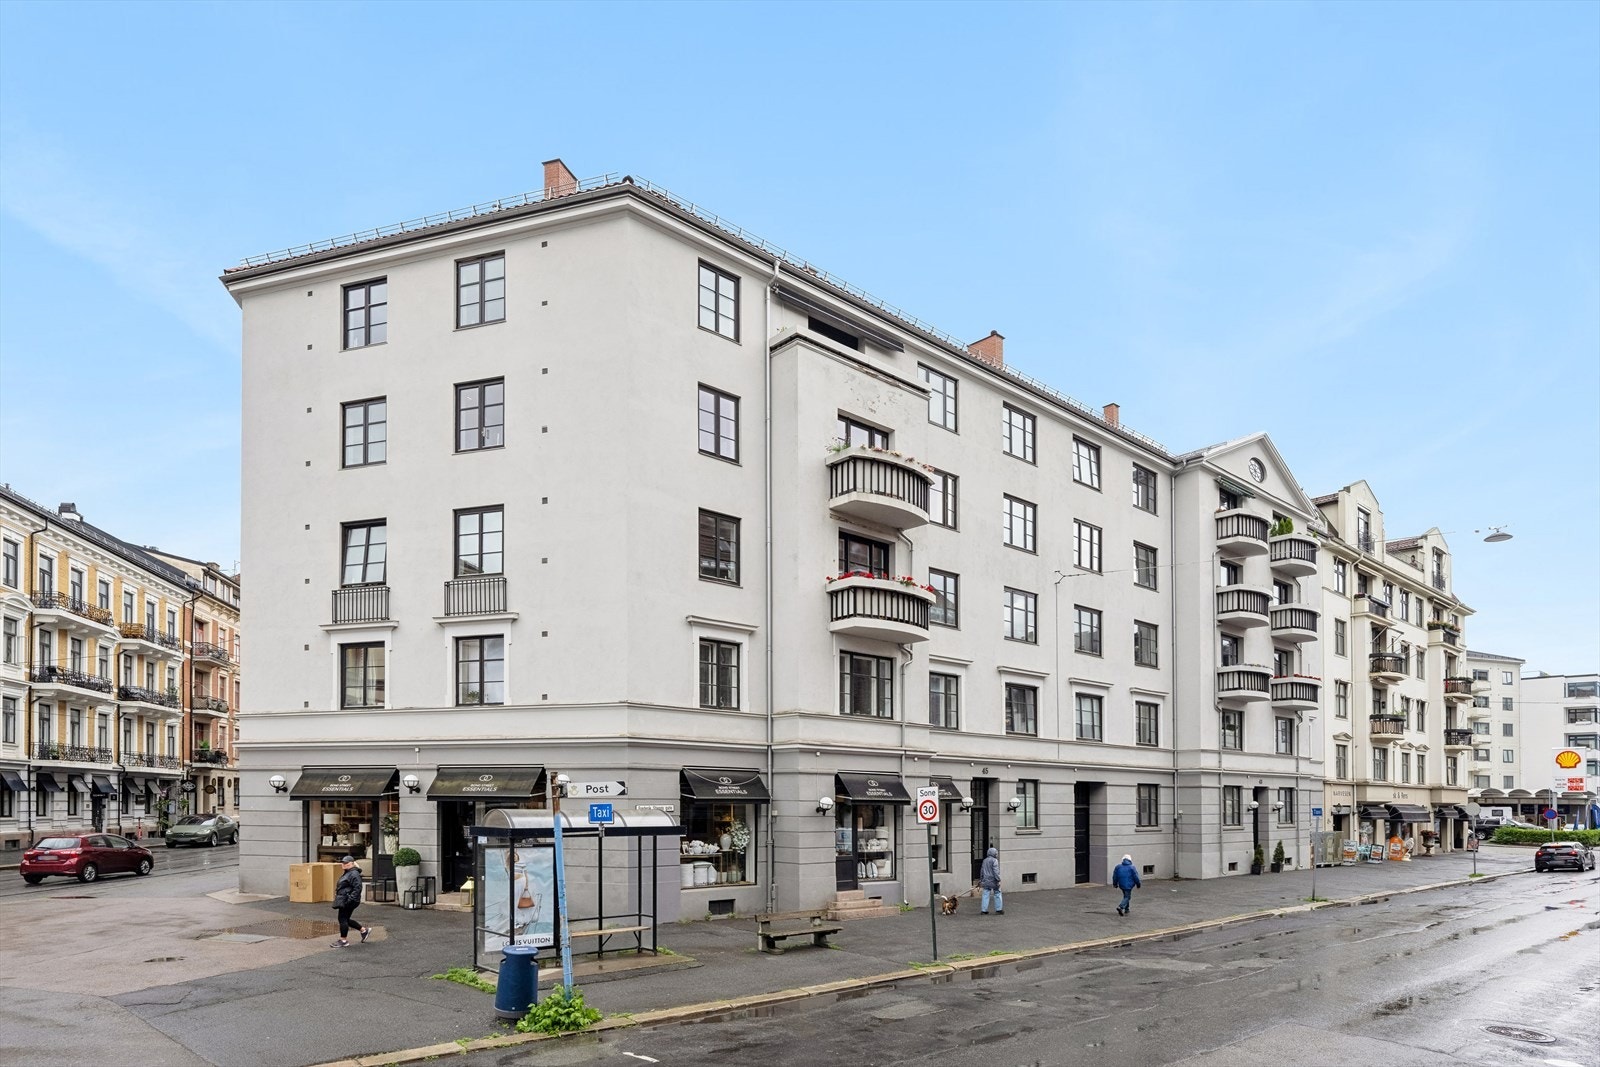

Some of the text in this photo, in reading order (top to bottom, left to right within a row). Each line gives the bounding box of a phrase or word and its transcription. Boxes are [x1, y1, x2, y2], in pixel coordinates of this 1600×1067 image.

[586, 785, 609, 793] Post
[919, 789, 936, 797] Sone
[593, 806, 610, 818] Taxi
[923, 806, 934, 815] 30
[502, 937, 550, 947] LOIS VUITTON
